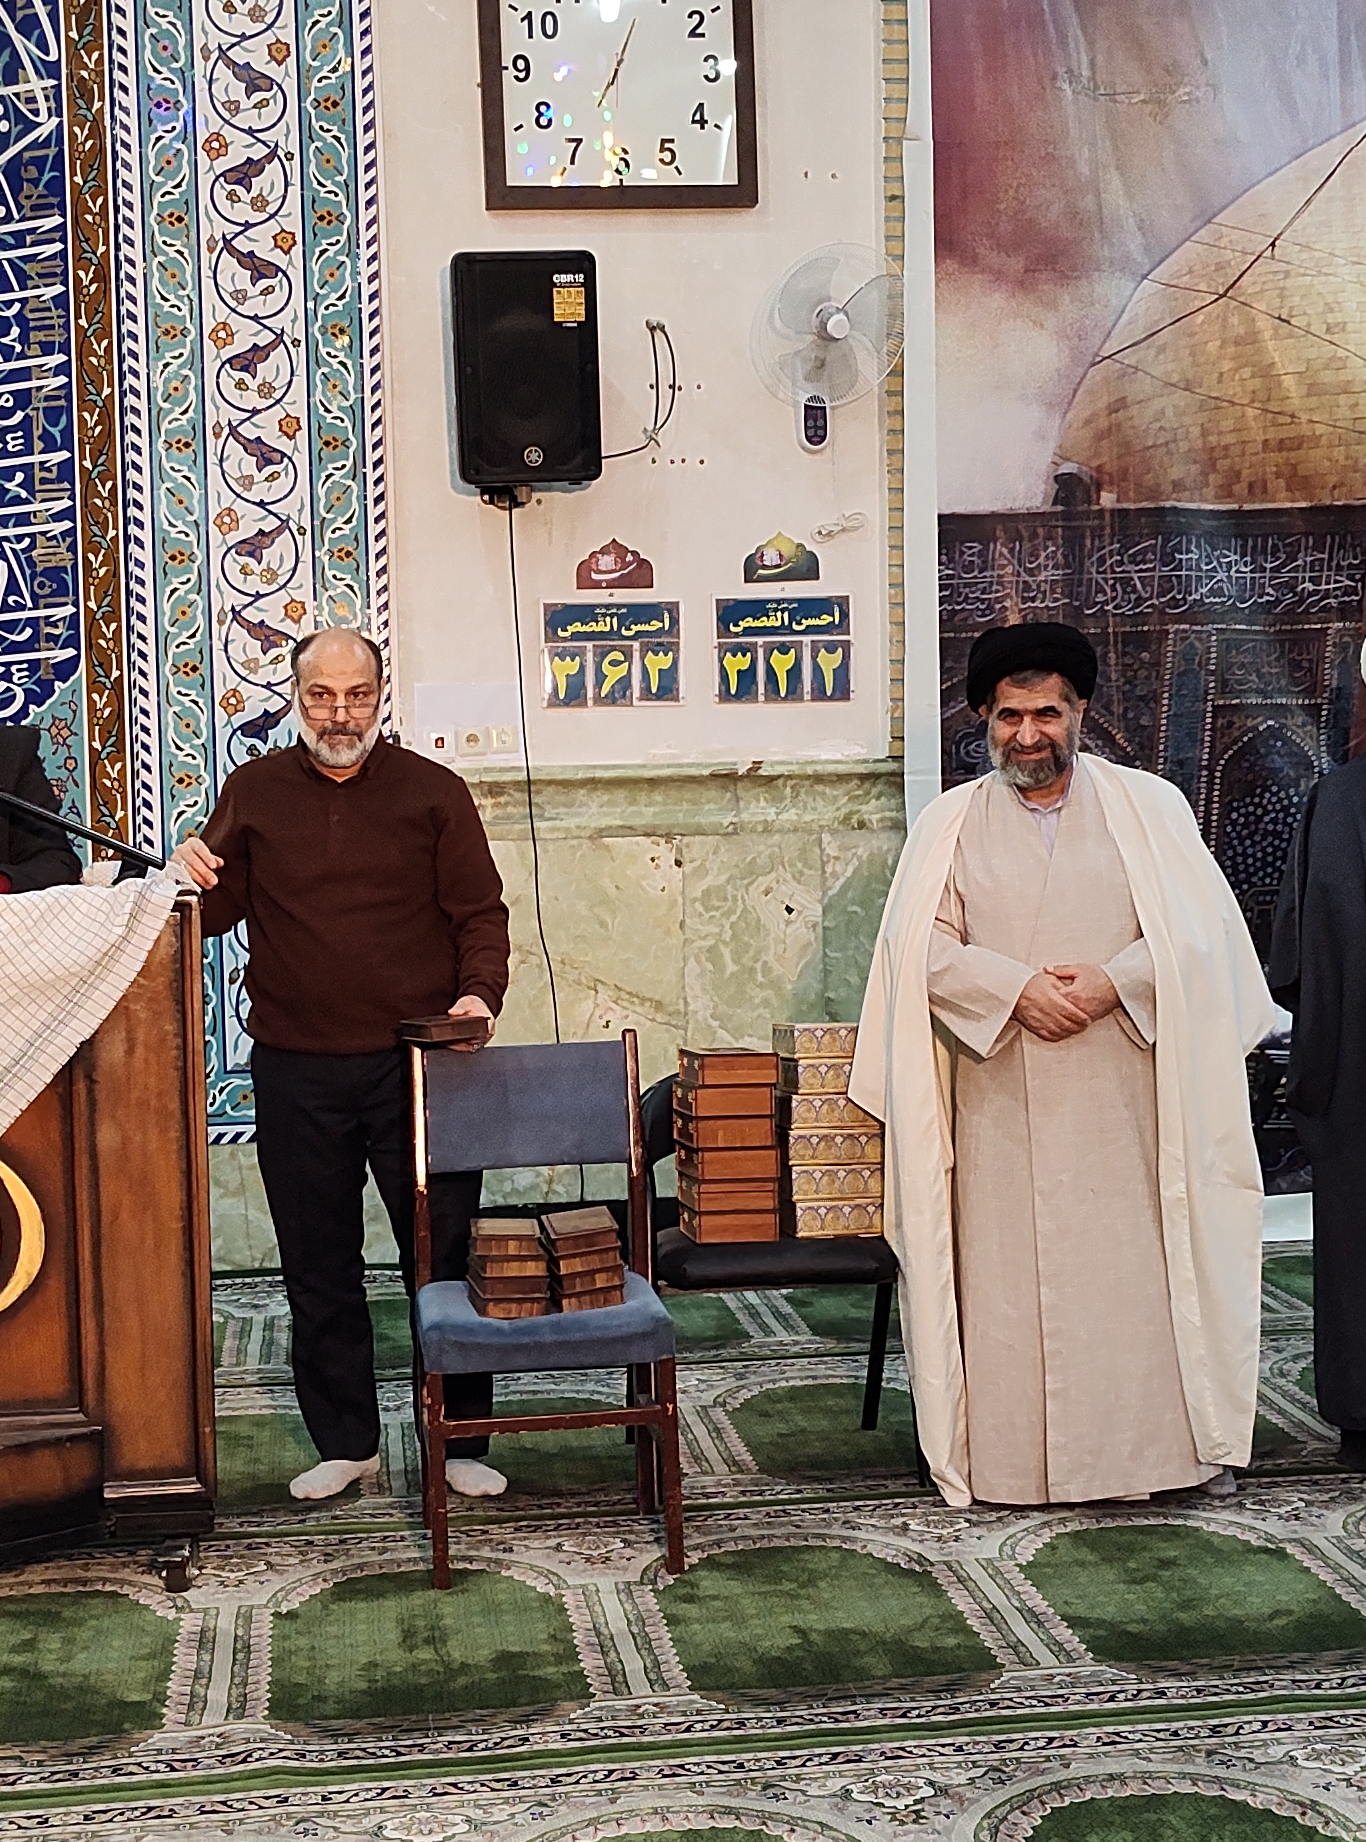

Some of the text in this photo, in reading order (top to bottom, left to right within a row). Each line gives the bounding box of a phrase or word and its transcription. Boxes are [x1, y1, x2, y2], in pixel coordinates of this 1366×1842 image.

[520, 10, 558, 40] 10
[686, 9, 706, 39] 2
[511, 54, 531, 83] 9
[703, 54, 721, 83] 3
[535, 101, 553, 130] 8
[691, 102, 708, 131] 4
[565, 138, 583, 166] 7
[612, 147, 631, 176] 6
[658, 138, 677, 167] 5
